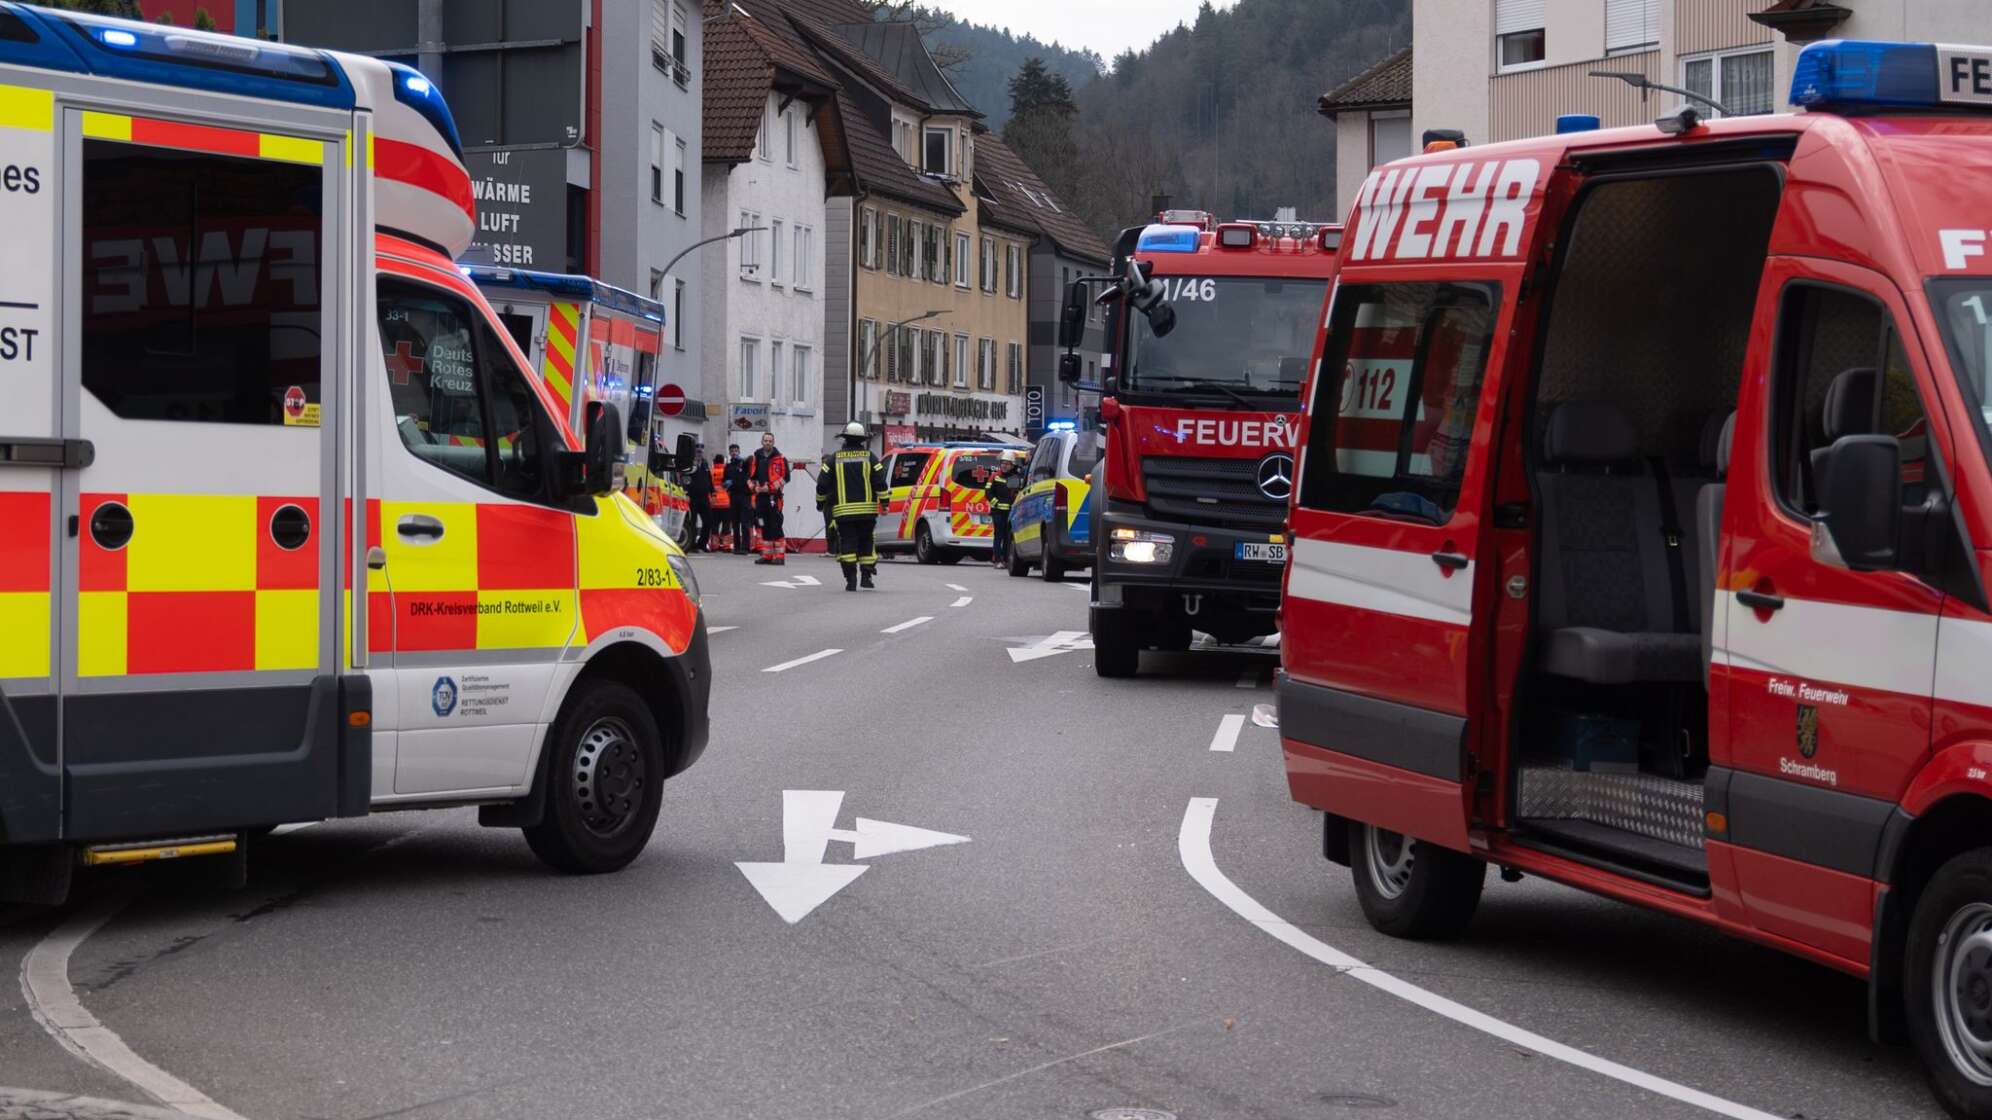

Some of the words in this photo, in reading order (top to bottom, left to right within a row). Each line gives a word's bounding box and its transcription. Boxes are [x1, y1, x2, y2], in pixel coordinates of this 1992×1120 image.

[0, 164, 40, 195] es
[471, 177, 530, 203] WÄRME
[480, 211, 520, 233] LUFT
[1352, 158, 1541, 262] WEHR
[471, 241, 533, 265] SSER
[1938, 229, 1992, 270] F
[432, 360, 473, 378] Rotes
[430, 375, 473, 392] Kreuz
[1358, 367, 1396, 411] 112
[1244, 545, 1260, 558] RW
[1269, 545, 1284, 559] SB
[637, 567, 672, 587] 2/83-1
[410, 600, 502, 617] DRK-Kreisverband
[504, 598, 544, 614] Rottweil
[545, 600, 562, 614] e.V.
[1768, 678, 1796, 697] Freiw.
[1798, 683, 1849, 706] Feuerwehr
[1779, 757, 1837, 786] Schramberg
